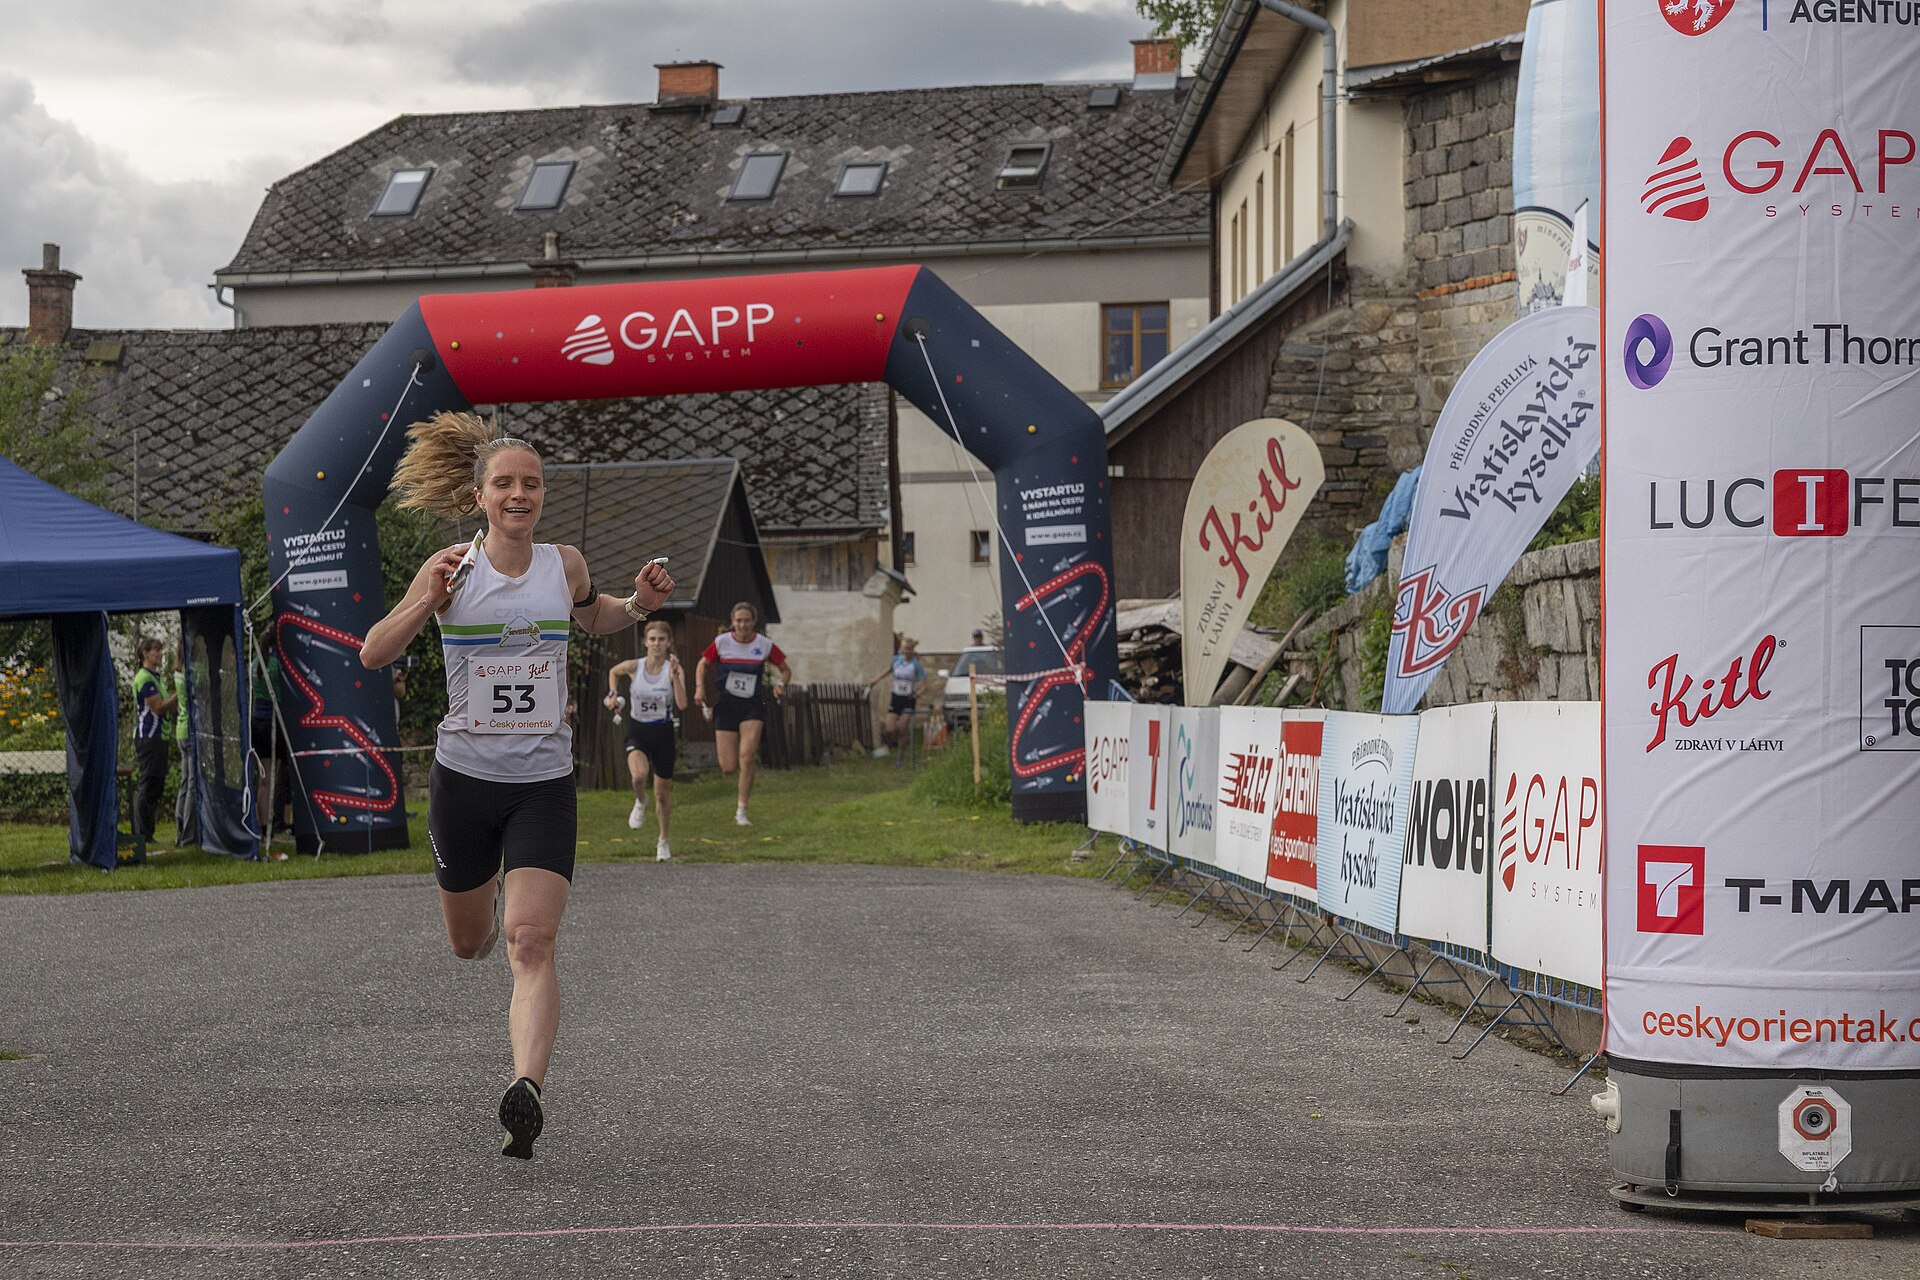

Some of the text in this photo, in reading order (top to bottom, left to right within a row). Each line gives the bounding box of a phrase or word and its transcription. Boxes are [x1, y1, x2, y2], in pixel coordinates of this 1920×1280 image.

[620, 303, 775, 350] GAPP
[647, 348, 751, 363] SYSTEM
[1690, 327, 1809, 368] Grant
[1449, 354, 1538, 471] PŘÍRODNĚ PERLIVÁ
[1439, 335, 1597, 521] Vratislavická
[1492, 401, 1594, 514] kyselka
[1020, 483, 1085, 501] VYSTARTUJ
[1199, 437, 1301, 600] Kitl
[283, 529, 346, 548] VYSTARTUJ
[321, 541, 346, 552] CESTU
[487, 665, 522, 676] GAPP
[492, 684, 536, 714] 53
[734, 680, 746, 691] 51
[1646, 634, 1776, 753] Kitl
[641, 702, 658, 712] 54
[490, 719, 553, 729] Český orienťák
[1100, 736, 1130, 783] GAPP
[1675, 738, 1784, 752] ZDRAVÍ V LÁHVI
[1404, 778, 1486, 875] INOV8
[1531, 881, 1597, 910] SYSTEM
